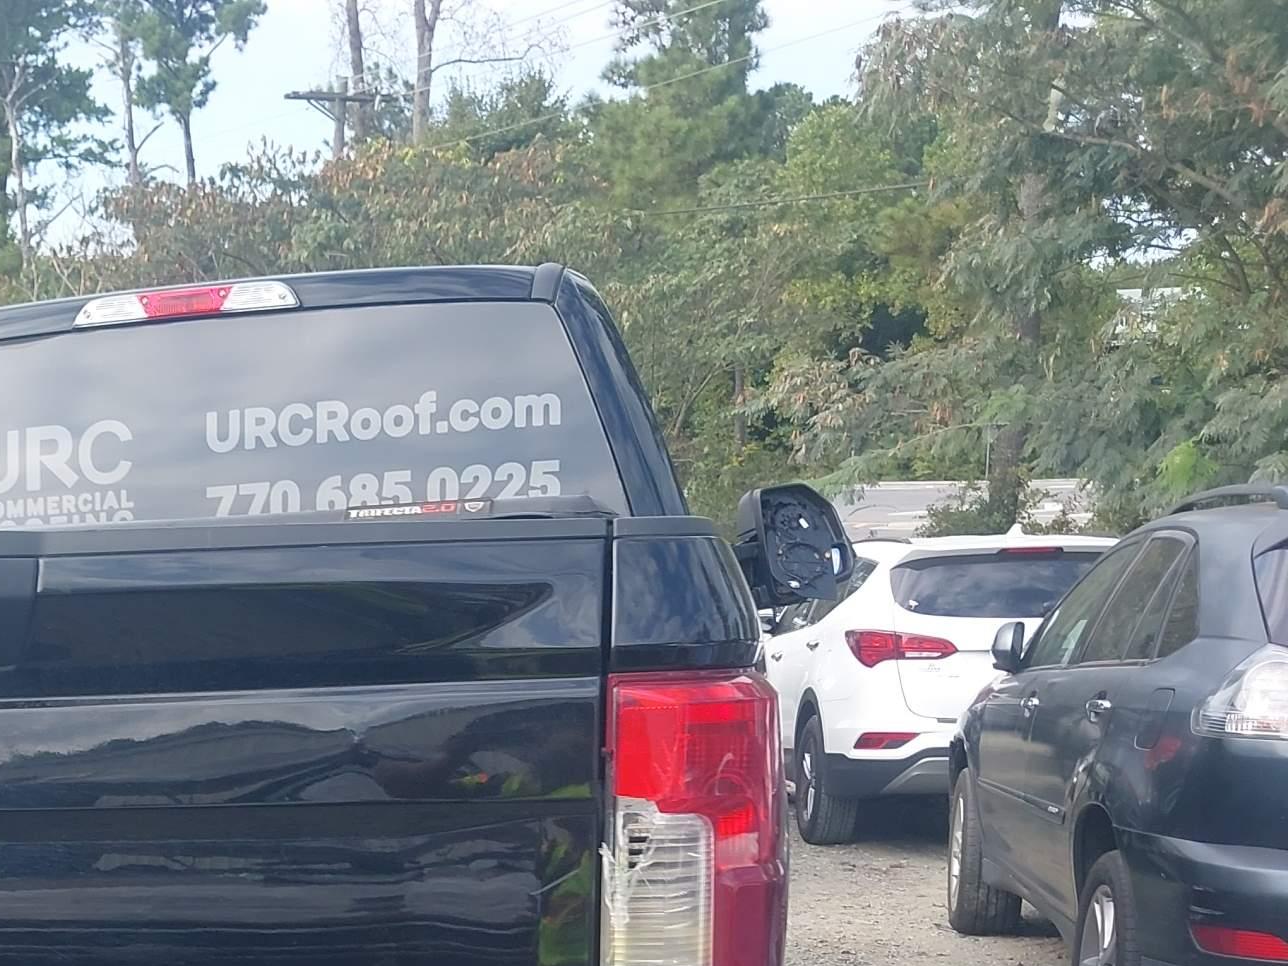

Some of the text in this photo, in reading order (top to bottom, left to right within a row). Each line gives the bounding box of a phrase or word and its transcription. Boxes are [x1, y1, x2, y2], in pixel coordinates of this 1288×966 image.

[206, 391, 561, 453] URCRoof.com
[206, 460, 561, 518] 770 685 0225
